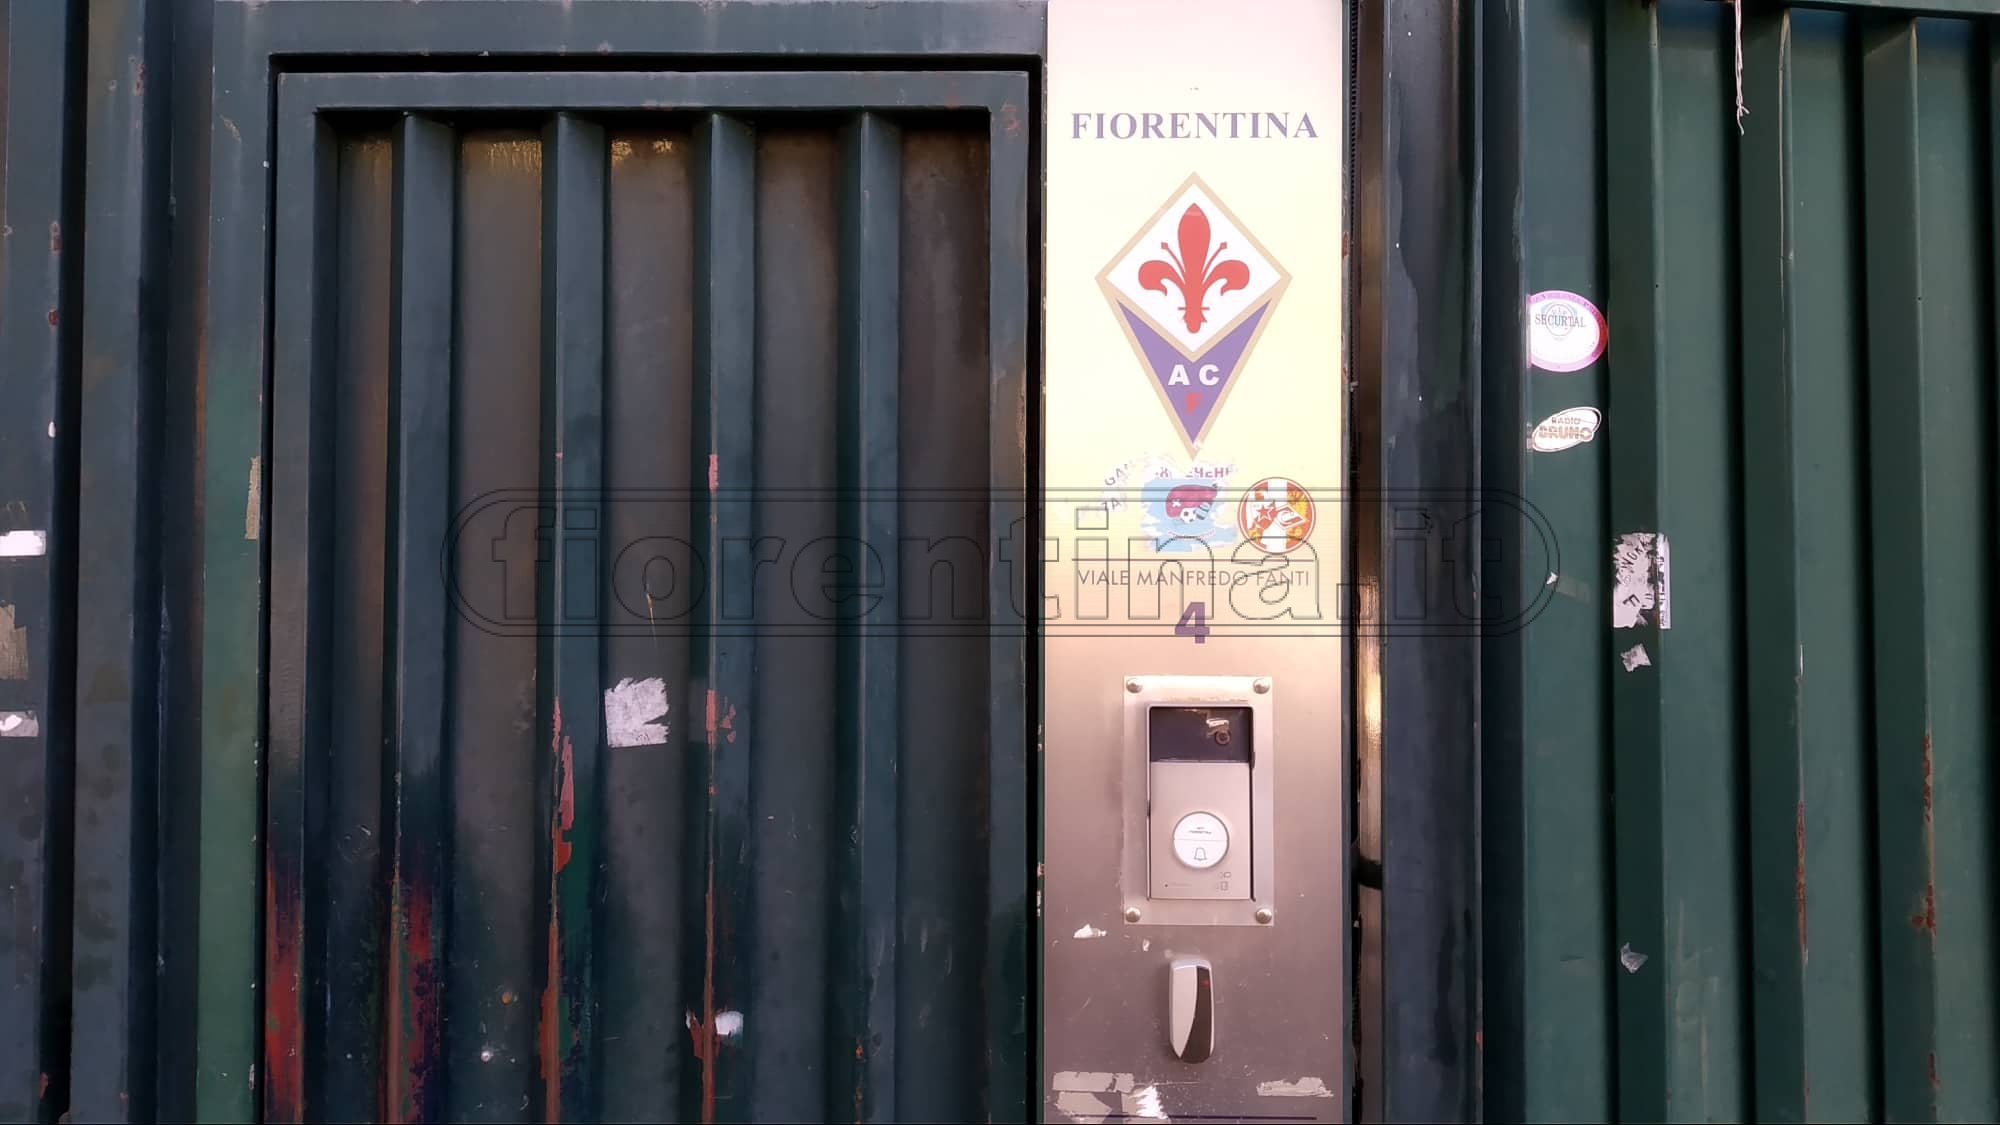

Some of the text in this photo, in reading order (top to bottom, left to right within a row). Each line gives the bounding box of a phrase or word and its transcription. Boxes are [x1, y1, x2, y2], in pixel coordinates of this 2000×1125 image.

[1071, 112, 1318, 139] FIORENTINA
[1551, 416, 1581, 425] RADIO
[1538, 425, 1593, 441] BRUNO
[1078, 570, 1310, 586] VIALE MANFREDO FANTI
[1174, 601, 1210, 644] 4
